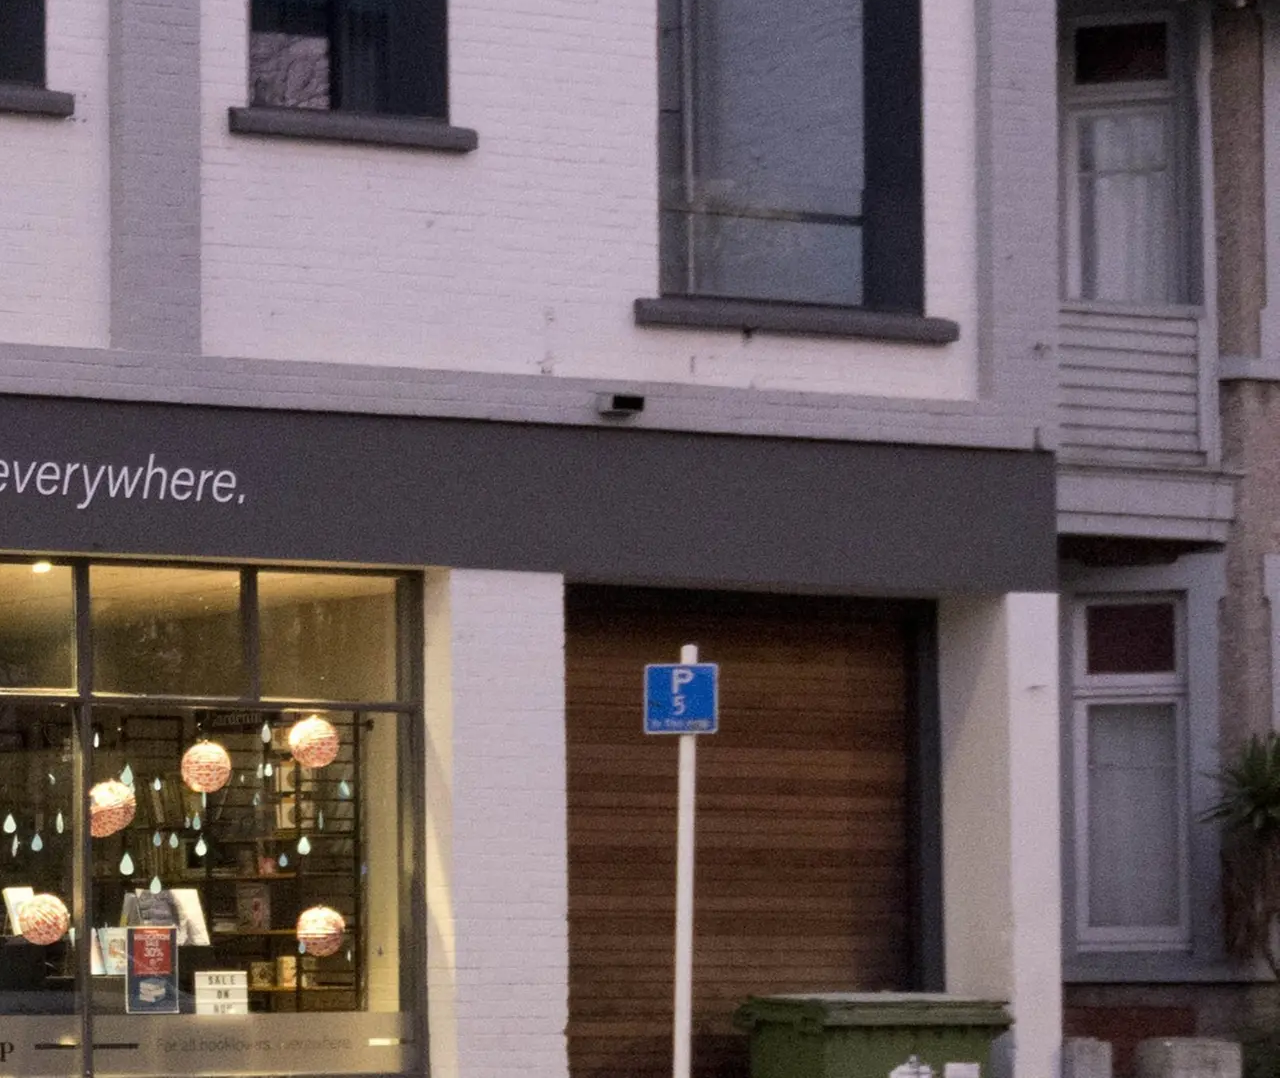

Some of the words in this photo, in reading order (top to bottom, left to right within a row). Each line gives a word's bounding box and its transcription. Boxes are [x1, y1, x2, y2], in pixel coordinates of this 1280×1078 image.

[672, 669, 695, 694] P
[673, 696, 686, 715] 5
[208, 976, 236, 985] SALE
